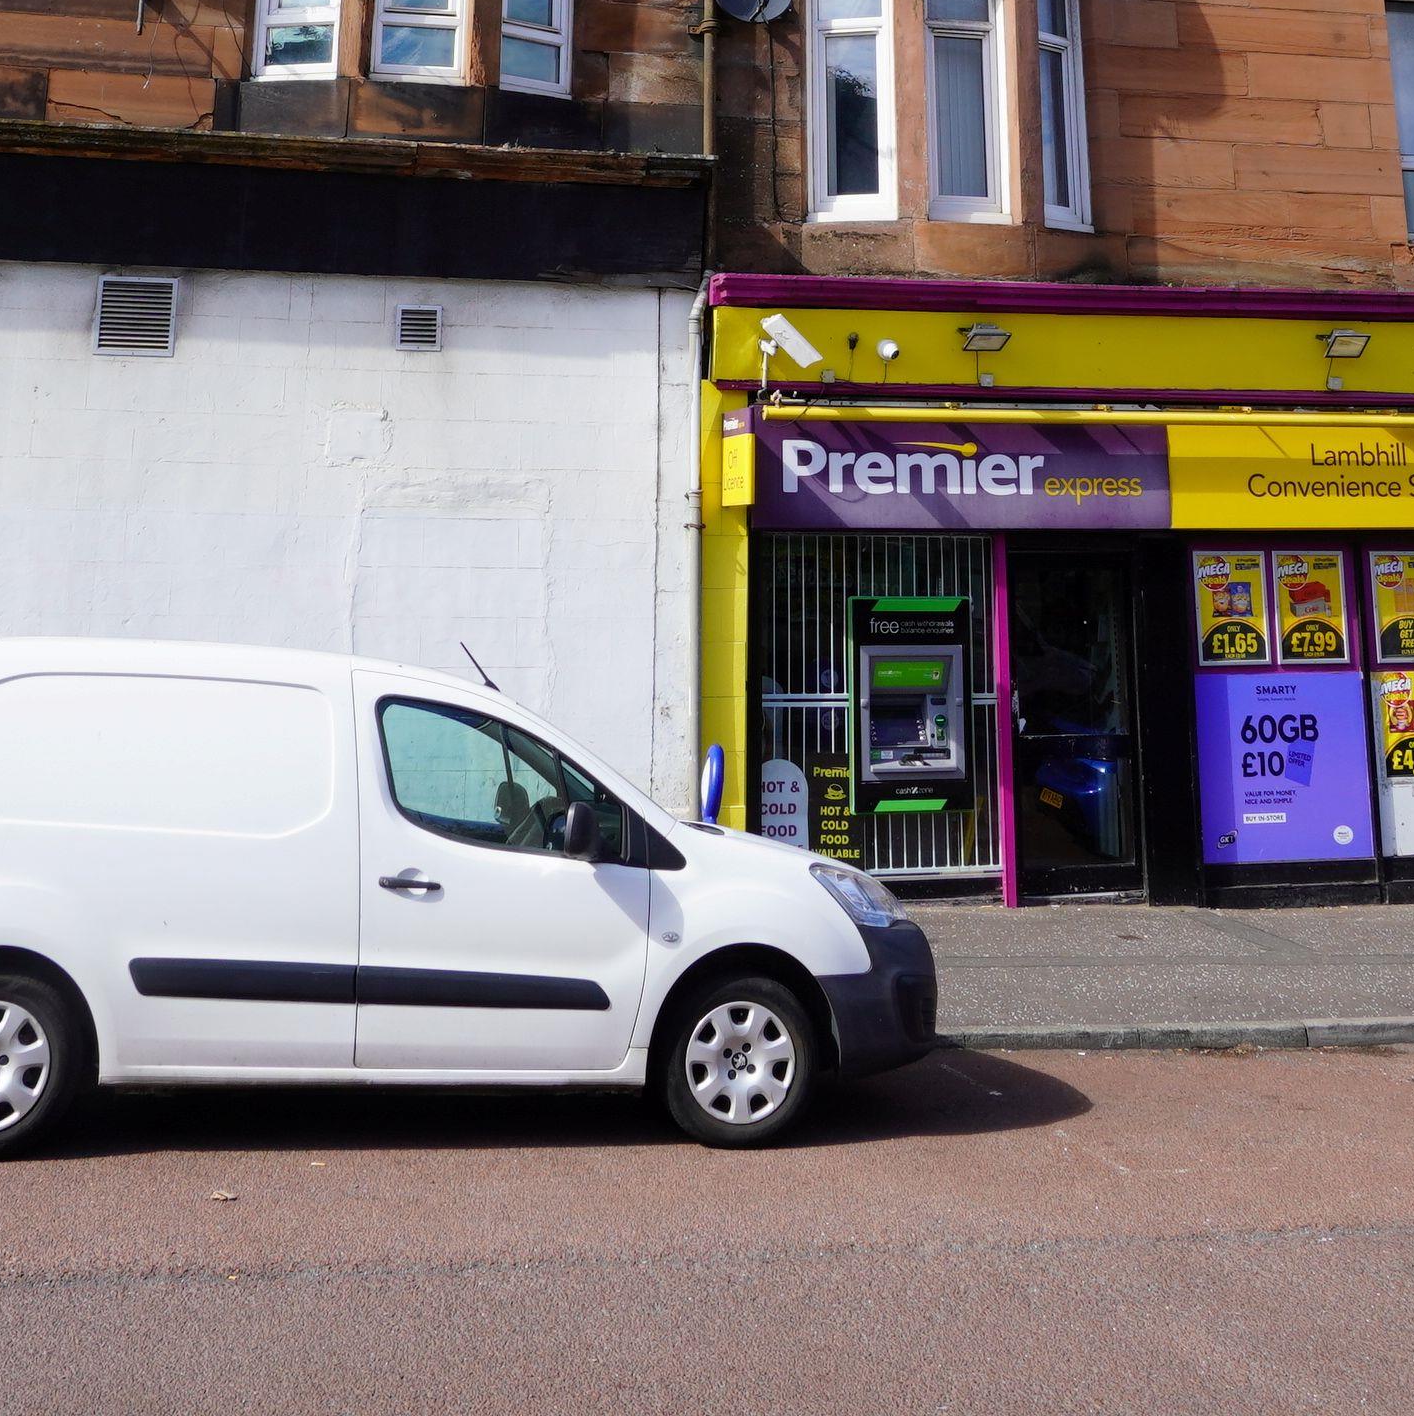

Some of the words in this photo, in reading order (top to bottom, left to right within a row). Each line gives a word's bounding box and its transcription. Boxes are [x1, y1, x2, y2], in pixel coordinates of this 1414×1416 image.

[1310, 442, 1407, 466] Lambhill
[782, 439, 1044, 495] Premier
[1044, 475, 1142, 505] express
[1247, 473, 1401, 497] Convenience
[1197, 562, 1230, 578] MEGA
[1277, 562, 1308, 578] MEGA
[1375, 561, 1403, 575] MEGA
[870, 617, 899, 634] free
[1398, 620, 1413, 629] BUY
[1399, 629, 1414, 639] GET
[1212, 633, 1258, 654] £1.65
[1291, 631, 1336, 652] £7.99
[1256, 685, 1296, 695] SMARTY
[1380, 678, 1411, 694] MEGA
[1241, 714, 1319, 744] 60GB
[1288, 758, 1305, 768] OFFER
[1289, 751, 1311, 762] LIMITED
[1242, 751, 1284, 777] £10
[790, 781, 800, 793] &
[761, 803, 796, 815] COLD
[820, 806, 841, 816] HOT
[843, 806, 850, 816] &
[821, 820, 849, 830] COLD
[820, 834, 849, 844] FOOD
[812, 848, 860, 858] VAILABLE
